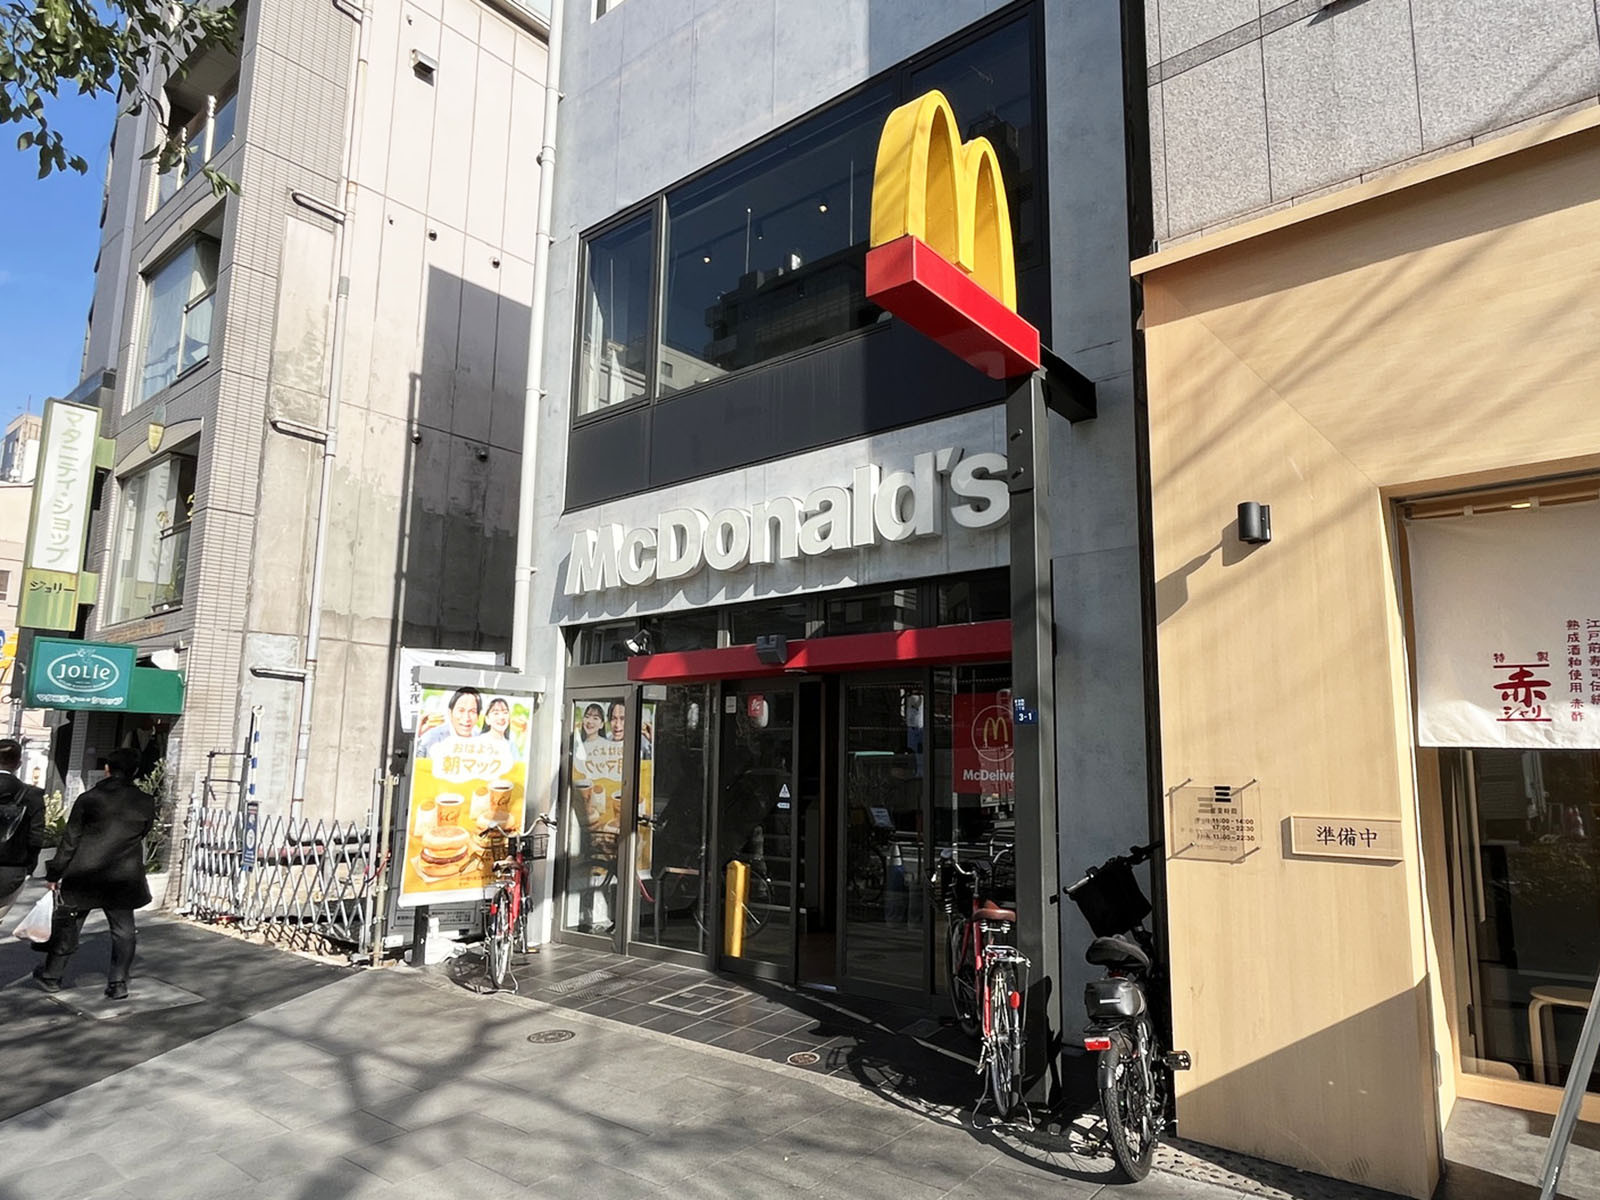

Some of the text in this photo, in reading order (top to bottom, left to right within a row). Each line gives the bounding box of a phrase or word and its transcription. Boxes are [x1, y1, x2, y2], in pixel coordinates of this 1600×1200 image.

[563, 446, 1010, 595] McDonald's
[29, 580, 76, 594] ジョリー
[1493, 667, 1551, 707] 赤
[1018, 712, 1032, 721] 3-1
[1503, 705, 1542, 719] シャリ
[443, 755, 501, 775] 朝マック
[1316, 825, 1377, 848] 準備中
